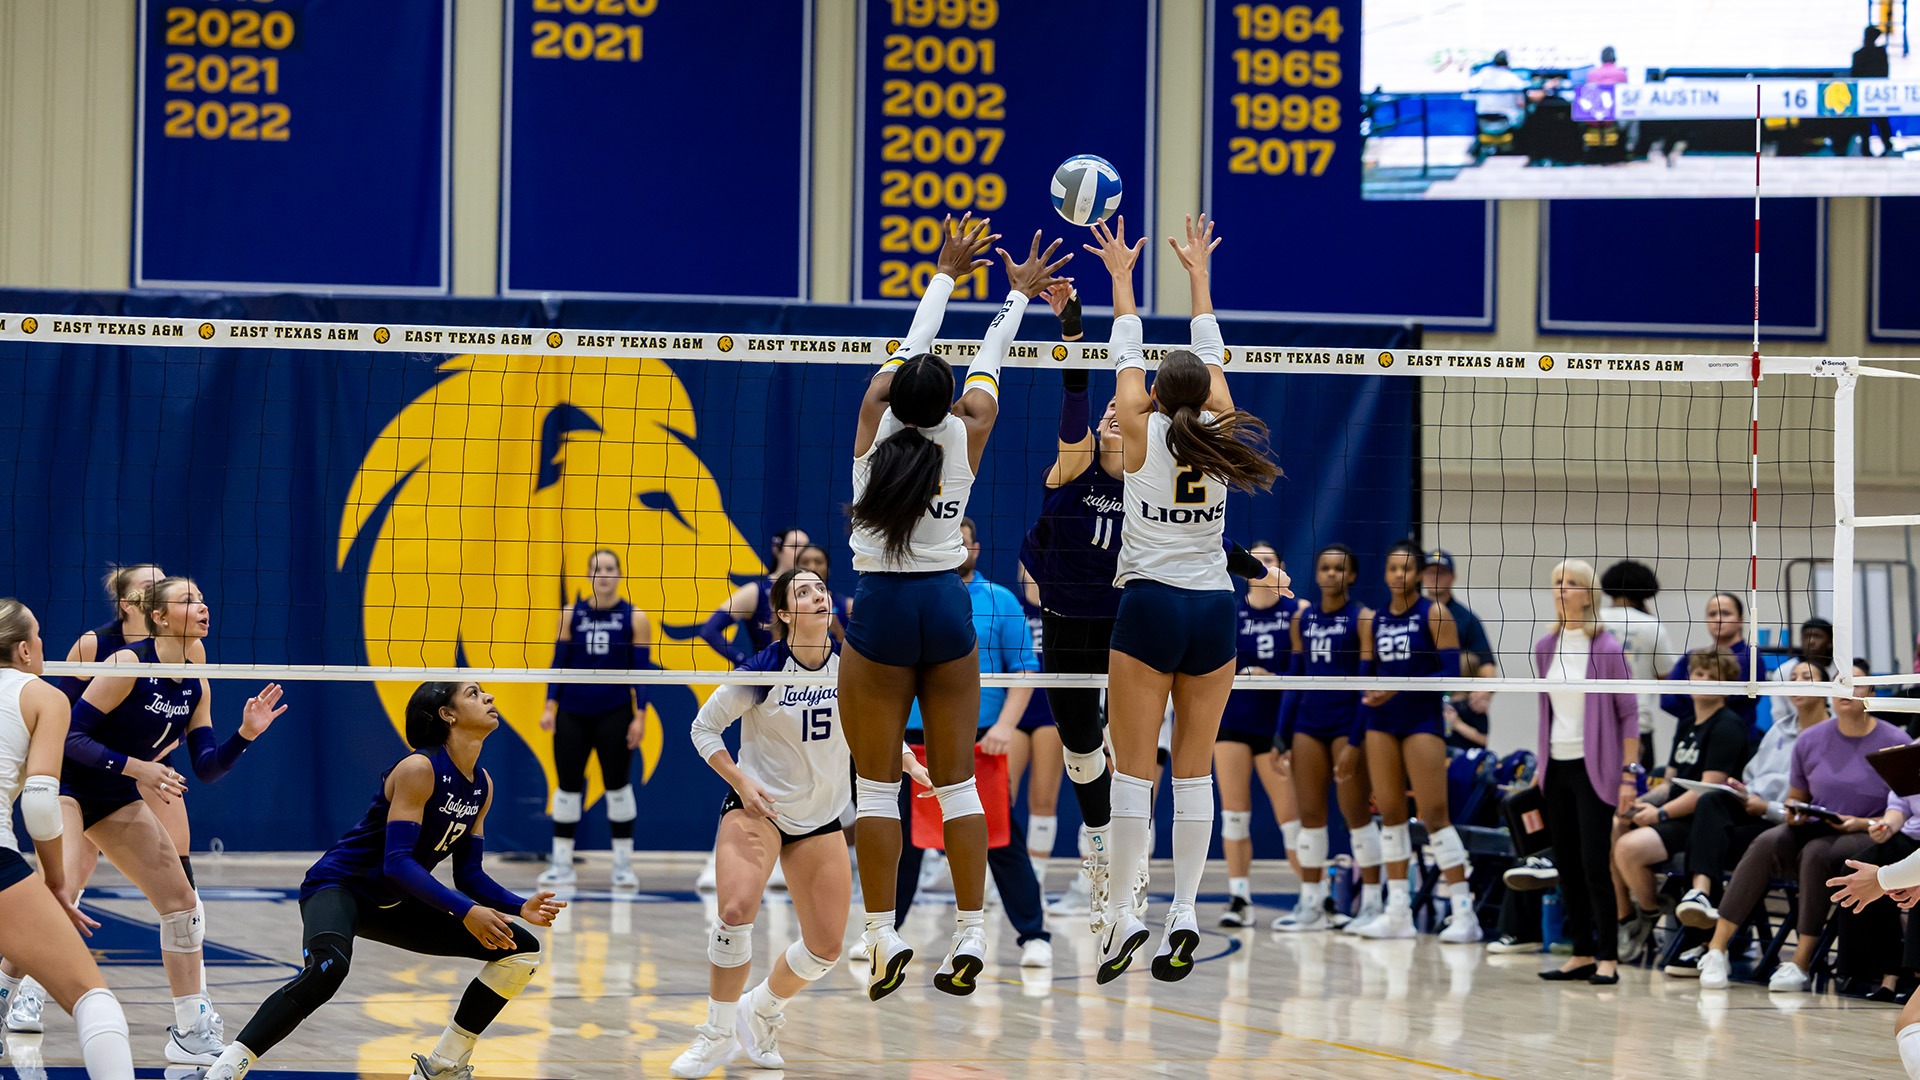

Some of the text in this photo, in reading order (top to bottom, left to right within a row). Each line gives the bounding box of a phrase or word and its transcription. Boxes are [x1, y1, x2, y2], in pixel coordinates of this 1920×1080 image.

[165, 7, 295, 50] 2020
[1233, 3, 1344, 43] 1964
[531, 21, 643, 61] 2021
[883, 34, 995, 75] 2001
[1231, 47, 1343, 88] 1965
[165, 53, 279, 95] 2021
[882, 79, 1006, 120] 2002
[1651, 90, 1719, 105] AUSTIN
[1782, 90, 1808, 108] 16
[1865, 86, 1899, 102] EAST
[164, 99, 291, 141] 2022
[1230, 92, 1341, 133] 1998
[881, 124, 1006, 165] 2007
[1228, 136, 1336, 177] 2017
[881, 169, 1007, 211] 2009
[53, 321, 184, 336] EAST TEXAS A&M
[230, 326, 359, 340] EAST TEXAS A&M
[405, 331, 532, 345] EAST TEXAS A&M
[577, 336, 703, 349] EAST TEXAS A&M
[748, 339, 872, 353] EAST TEXAS A&M
[1008, 347, 1038, 358] A&M
[1082, 348, 1168, 361] EAS XAS
[1245, 352, 1365, 365] EAST TEXAS A&M
[1407, 355, 1525, 368] EAST TEXAS A&M
[1567, 358, 1684, 371] EAST TEXAS A&M
[1174, 459, 1207, 505] 2
[1141, 500, 1225, 523] LIONS
[1091, 516, 1113, 550] 11
[1256, 633, 1274, 659] 2
[1311, 637, 1332, 663] 14
[1377, 634, 1411, 662] 23
[152, 722, 172, 748] 1
[802, 708, 832, 742] 15
